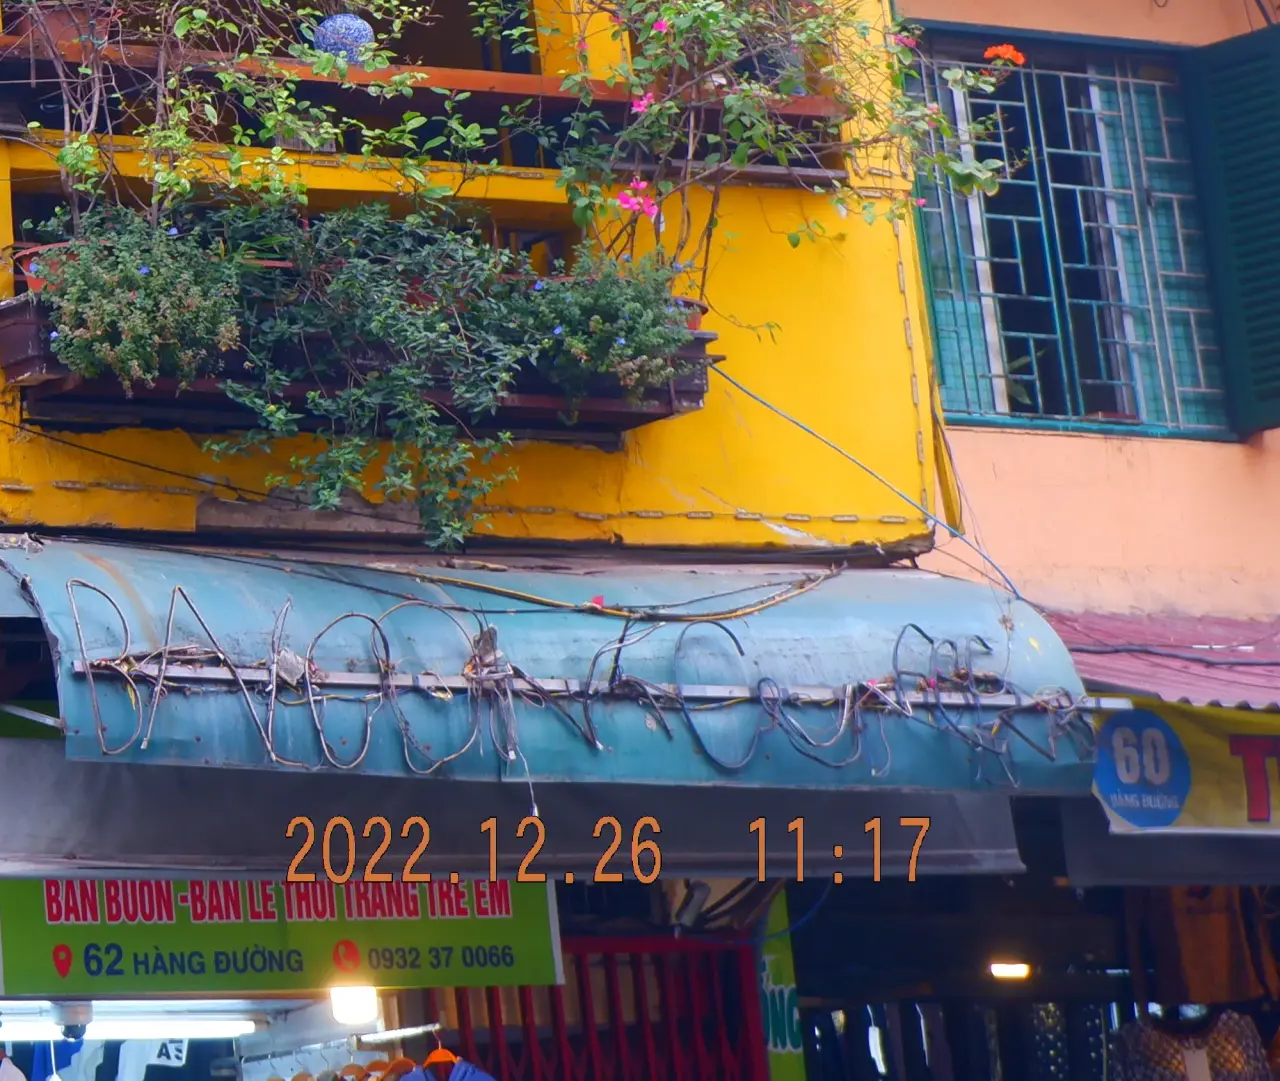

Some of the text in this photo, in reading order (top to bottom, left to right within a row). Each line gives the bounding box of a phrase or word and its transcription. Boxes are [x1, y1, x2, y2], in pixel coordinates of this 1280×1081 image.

[1111, 726, 1171, 785] 60
[1228, 733, 1280, 823] T
[473, 878, 514, 919] EM
[83, 942, 515, 977] 62 HÀNG ĐƯỜNG 0932 37 0066
